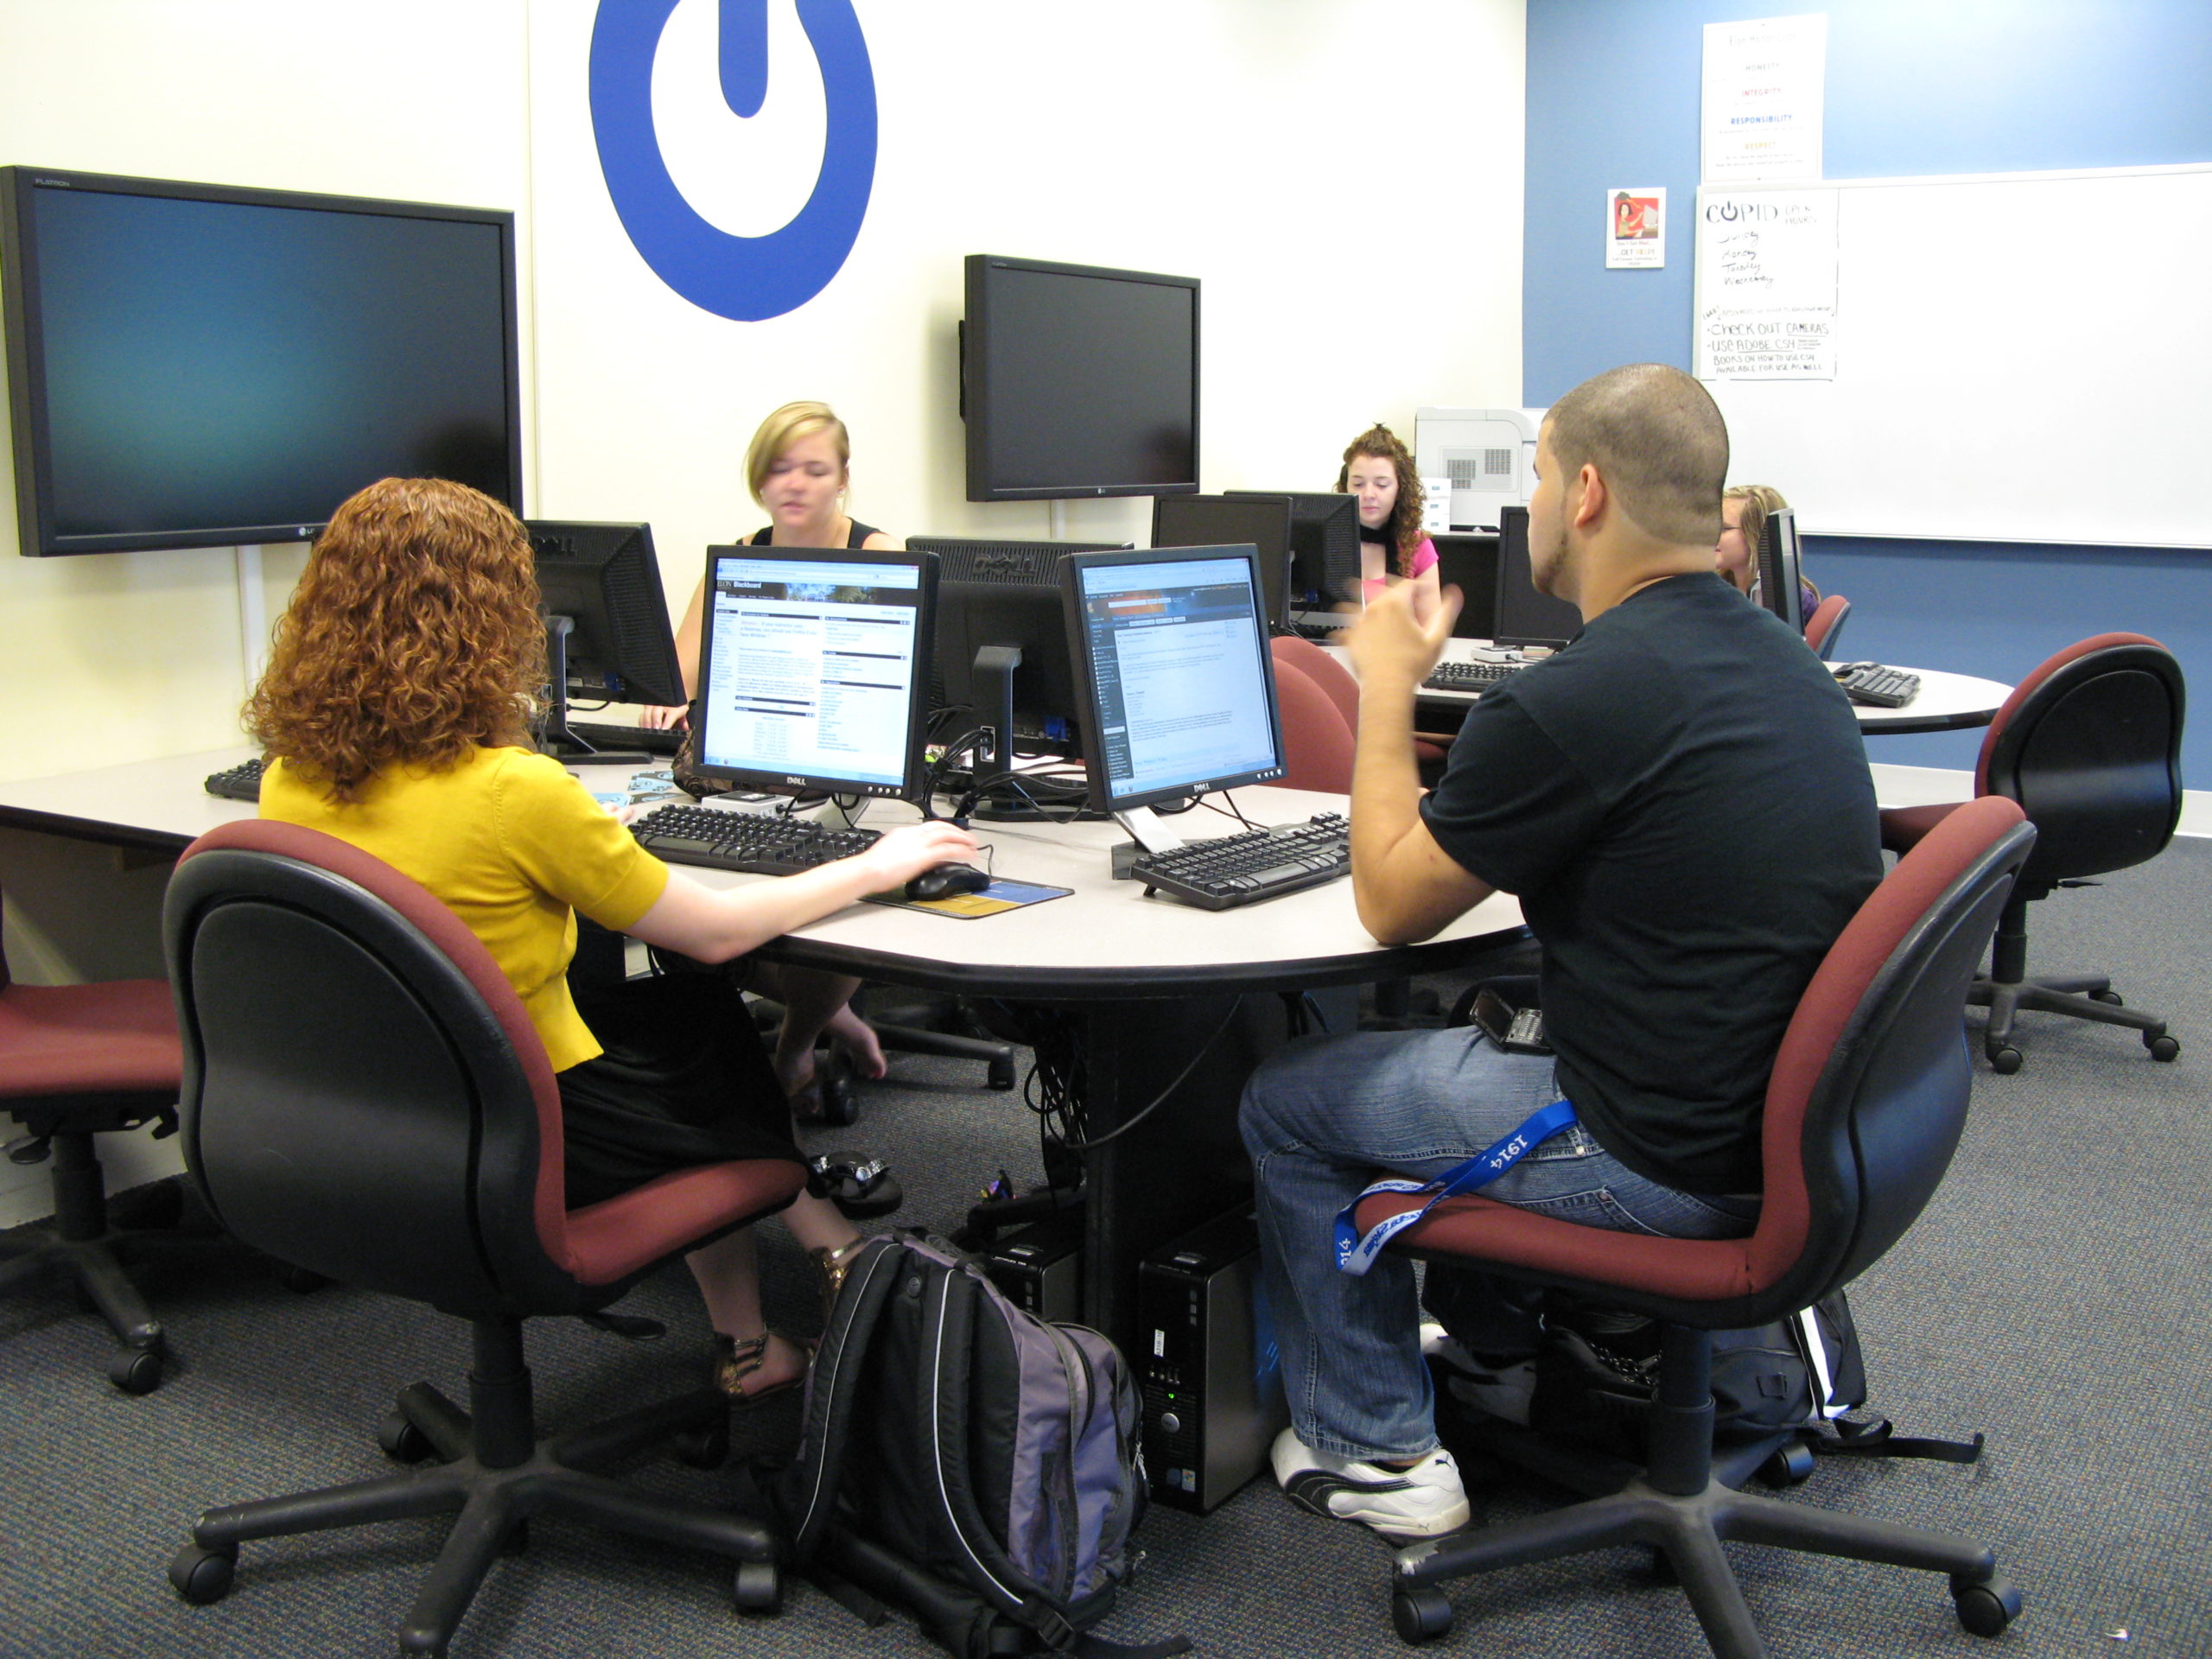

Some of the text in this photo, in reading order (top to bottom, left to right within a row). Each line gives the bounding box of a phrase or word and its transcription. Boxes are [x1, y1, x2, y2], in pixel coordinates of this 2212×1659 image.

[1742, 87, 1782, 97] INTEGRITY
[1731, 114, 1792, 125] RESPONSIBILITY
[1745, 142, 1776, 150] RESPECT
[1758, 322, 1782, 334] OUT
[1786, 322, 1829, 335] CAMERAS
[1737, 339, 1770, 350] ADOBE
[1775, 339, 1796, 349] CS4
[1713, 355, 1743, 365] BOOKS
[1745, 353, 1755, 363] ON
[1716, 365, 1756, 373] AVAILABLE
[787, 776, 806, 786] DELL
[1193, 782, 1211, 792] DELL
[1490, 1134, 1529, 1169] 1914
